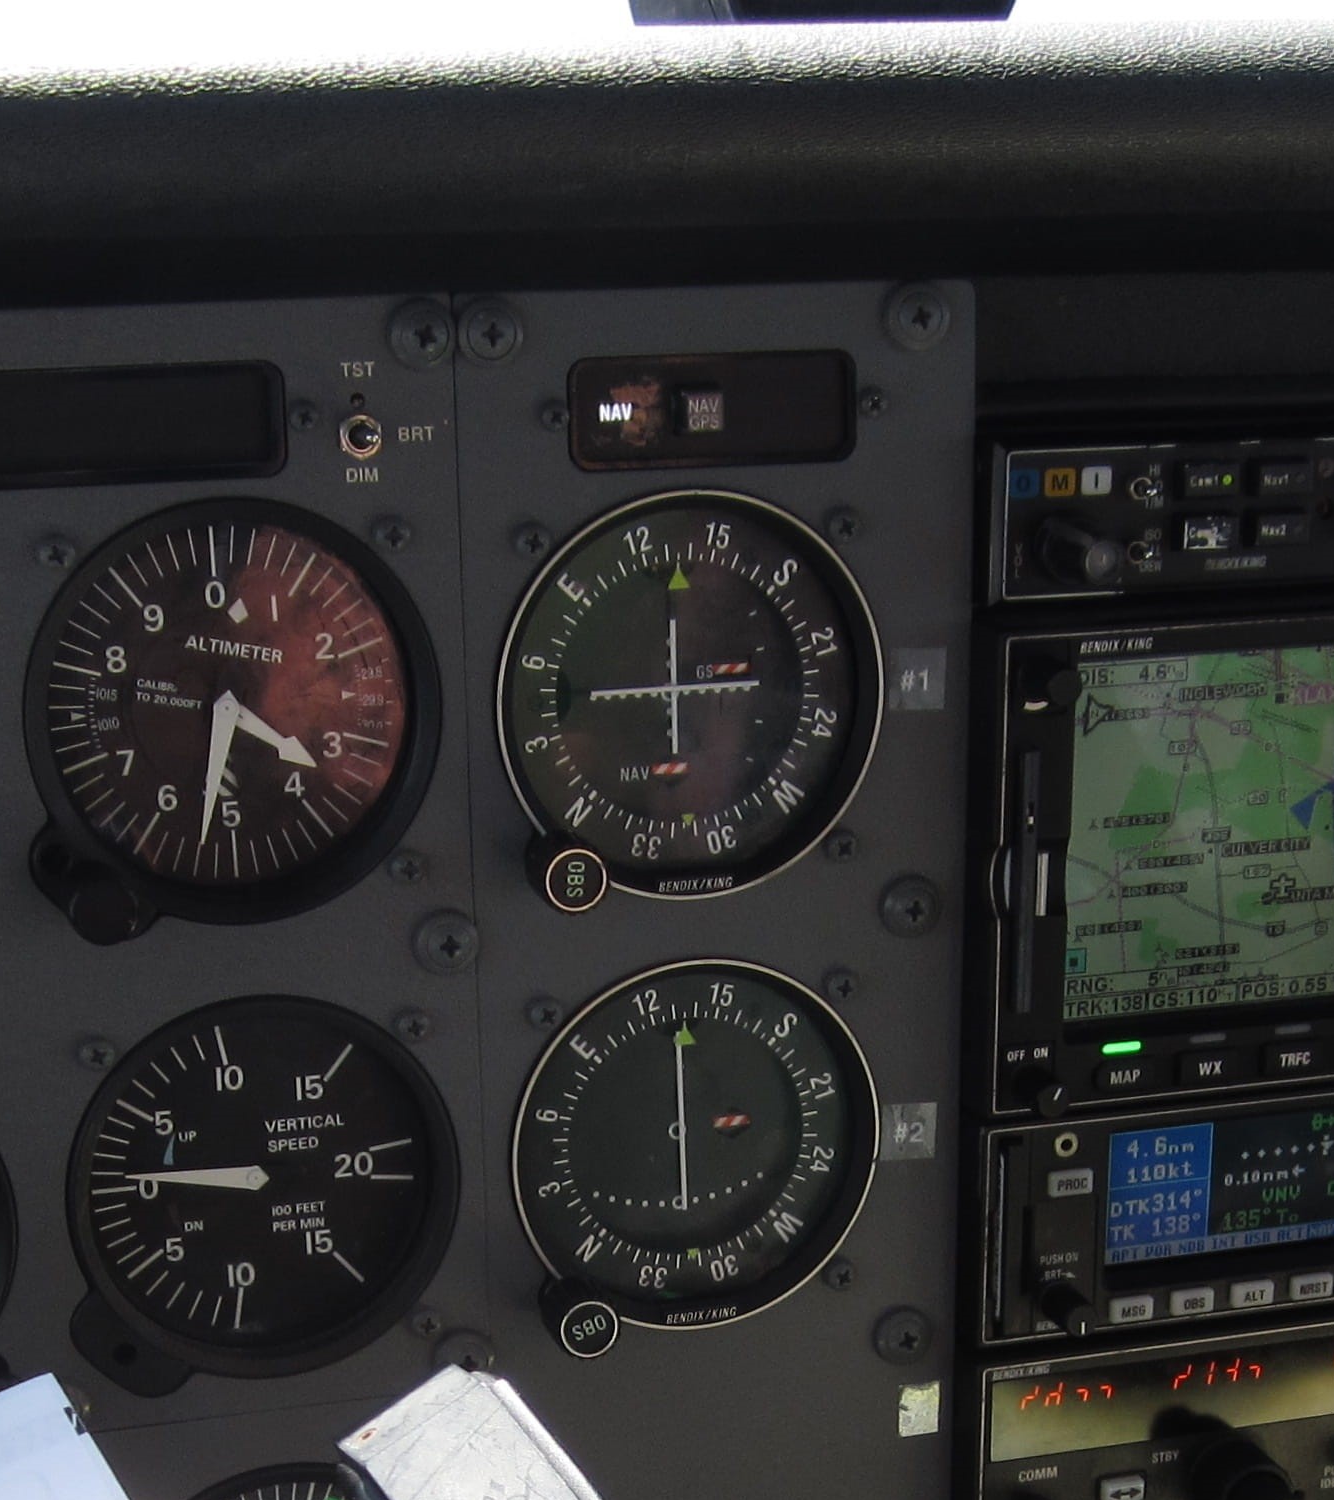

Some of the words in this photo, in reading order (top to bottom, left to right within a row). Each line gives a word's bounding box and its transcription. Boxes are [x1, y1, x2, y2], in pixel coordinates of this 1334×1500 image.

[340, 361, 375, 378] TST
[398, 426, 434, 442] BRT
[346, 467, 379, 483] DIM
[704, 521, 732, 550] 15
[184, 634, 284, 663] ALTIMETER
[899, 670, 930, 692] #1
[620, 765, 649, 782] NAV
[658, 876, 733, 892] BENDIX/KING
[1065, 973, 1114, 996] RNG:
[709, 982, 735, 1007] 15
[1200, 1060, 1223, 1076] WX
[1281, 1051, 1311, 1069] TRFC
[215, 1065, 244, 1091] 10
[1110, 1068, 1141, 1085] MAP
[295, 1074, 324, 1101] 15
[264, 1113, 345, 1134] VERTICAL
[178, 1130, 197, 1143] UP
[893, 1123, 924, 1143] #2
[267, 1136, 319, 1153] SPEED
[334, 1152, 373, 1179] 20
[296, 1200, 326, 1214] FEET
[183, 1219, 204, 1233] DN
[272, 1219, 296, 1233] PER
[300, 1216, 325, 1230] MIN
[305, 1229, 334, 1255] 15
[227, 1262, 256, 1288] 10
[666, 1306, 737, 1325] BENDIX/KING
[1152, 1449, 1180, 1464] STBY
[1018, 1465, 1058, 1483] COMM
